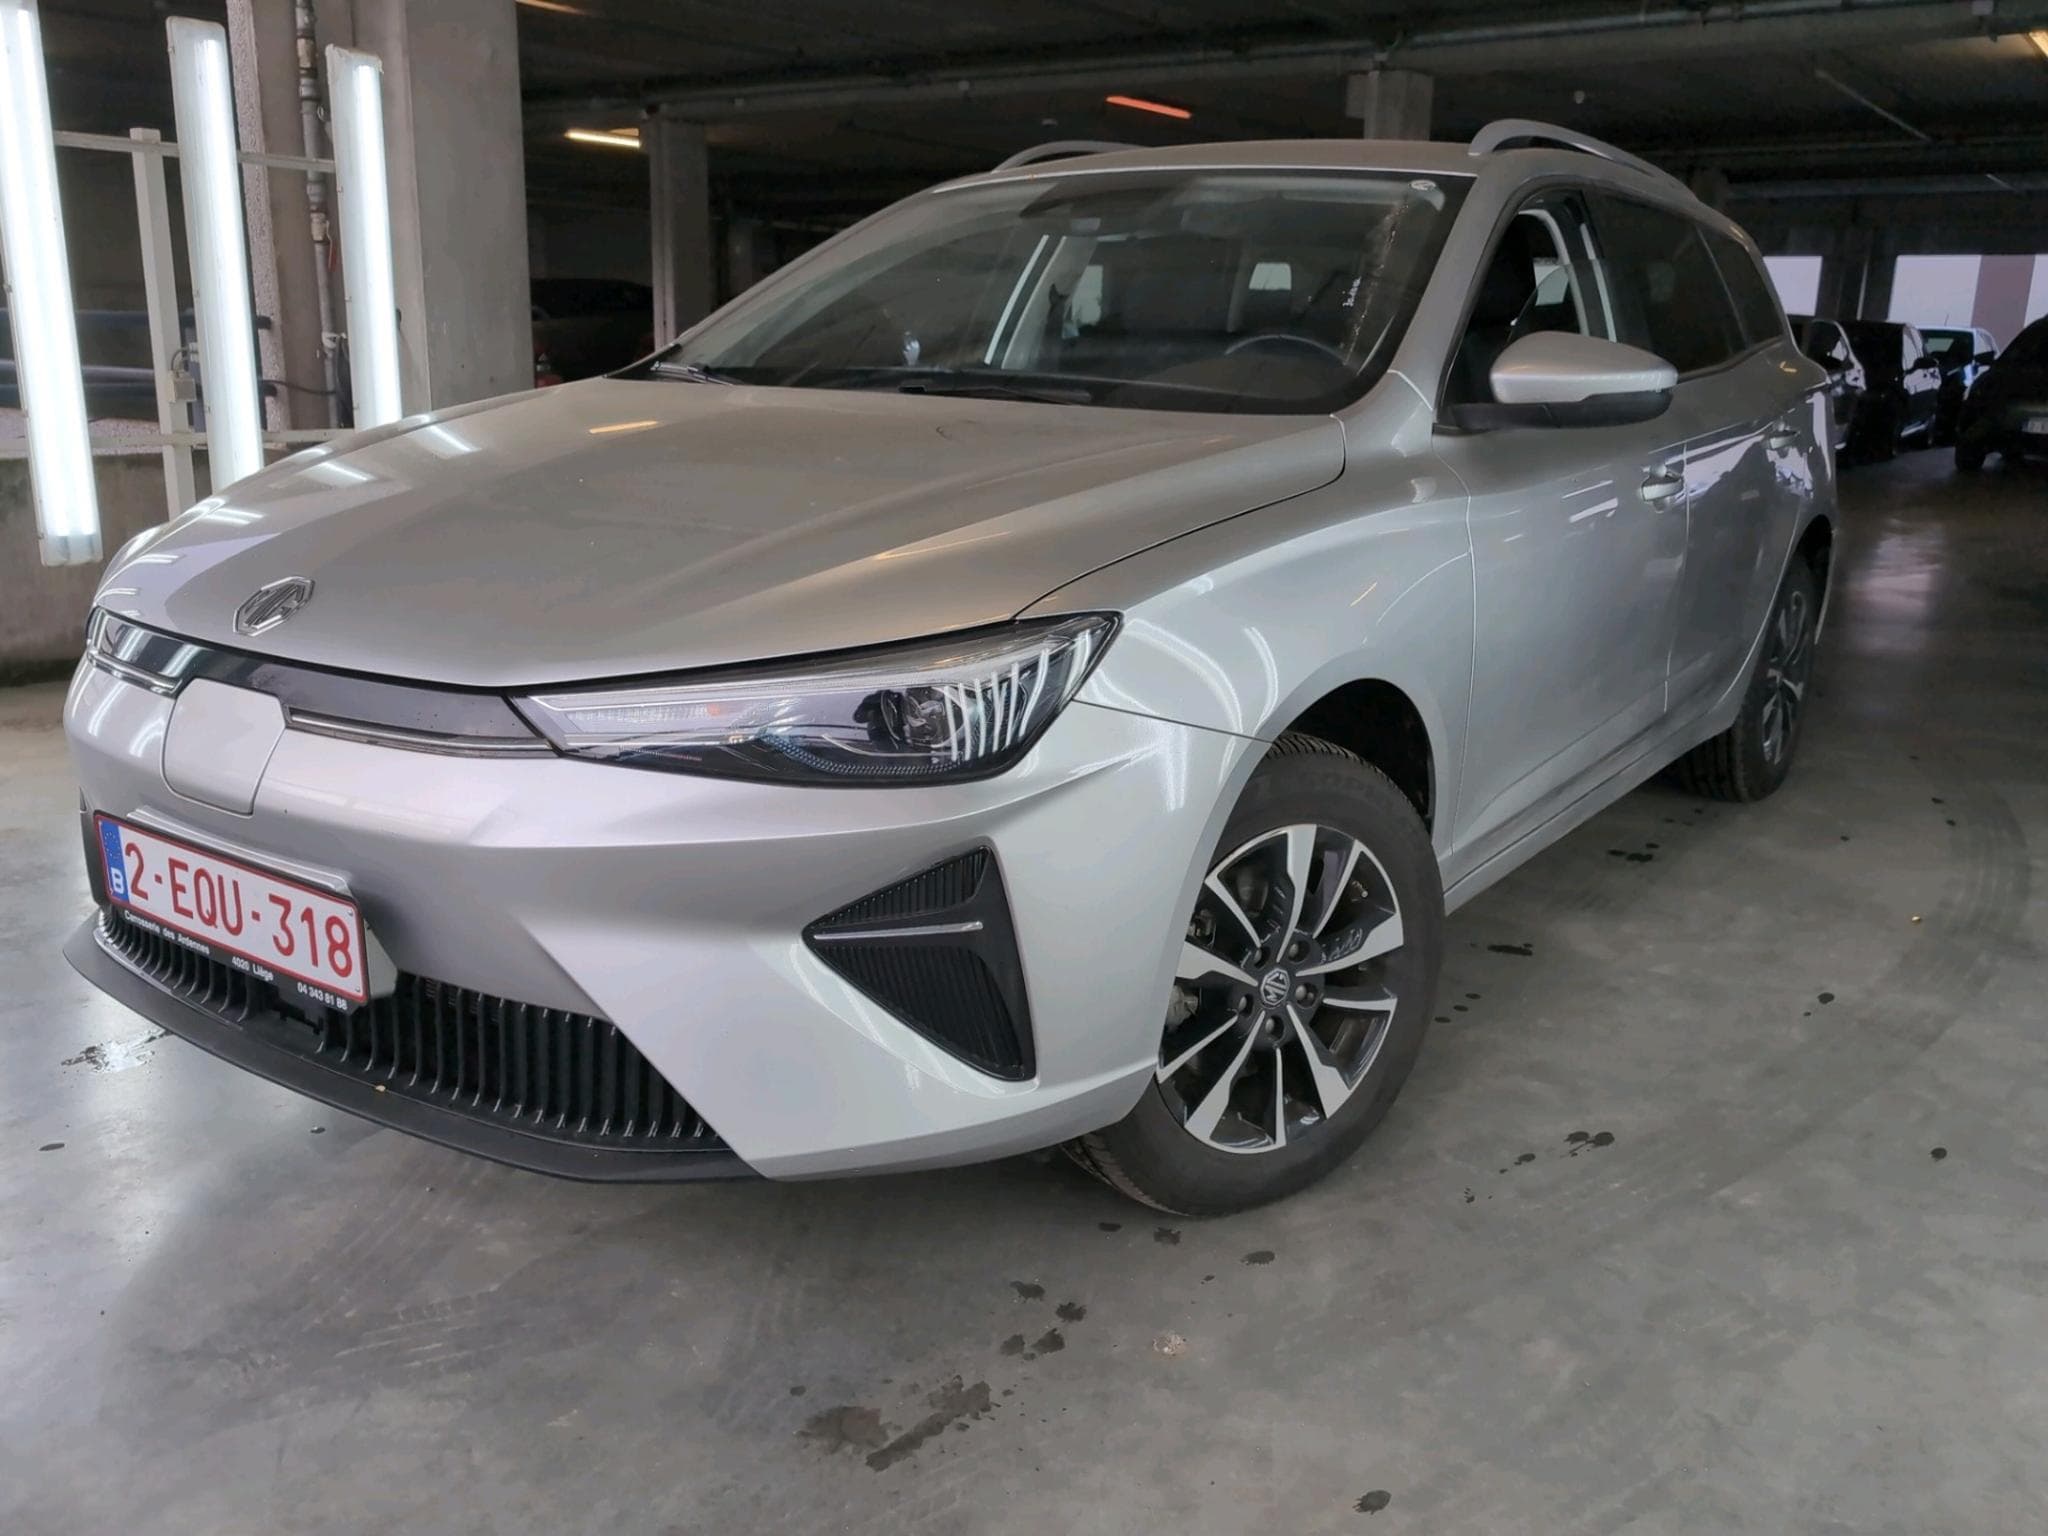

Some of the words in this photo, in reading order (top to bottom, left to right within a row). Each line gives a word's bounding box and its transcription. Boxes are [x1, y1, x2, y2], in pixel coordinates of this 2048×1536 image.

[110, 867, 125, 894] B
[125, 842, 353, 978] 2-EQU-318
[297, 982, 308, 995] 04
[308, 986, 324, 1002] 343
[1263, 971, 1287, 1002] MG
